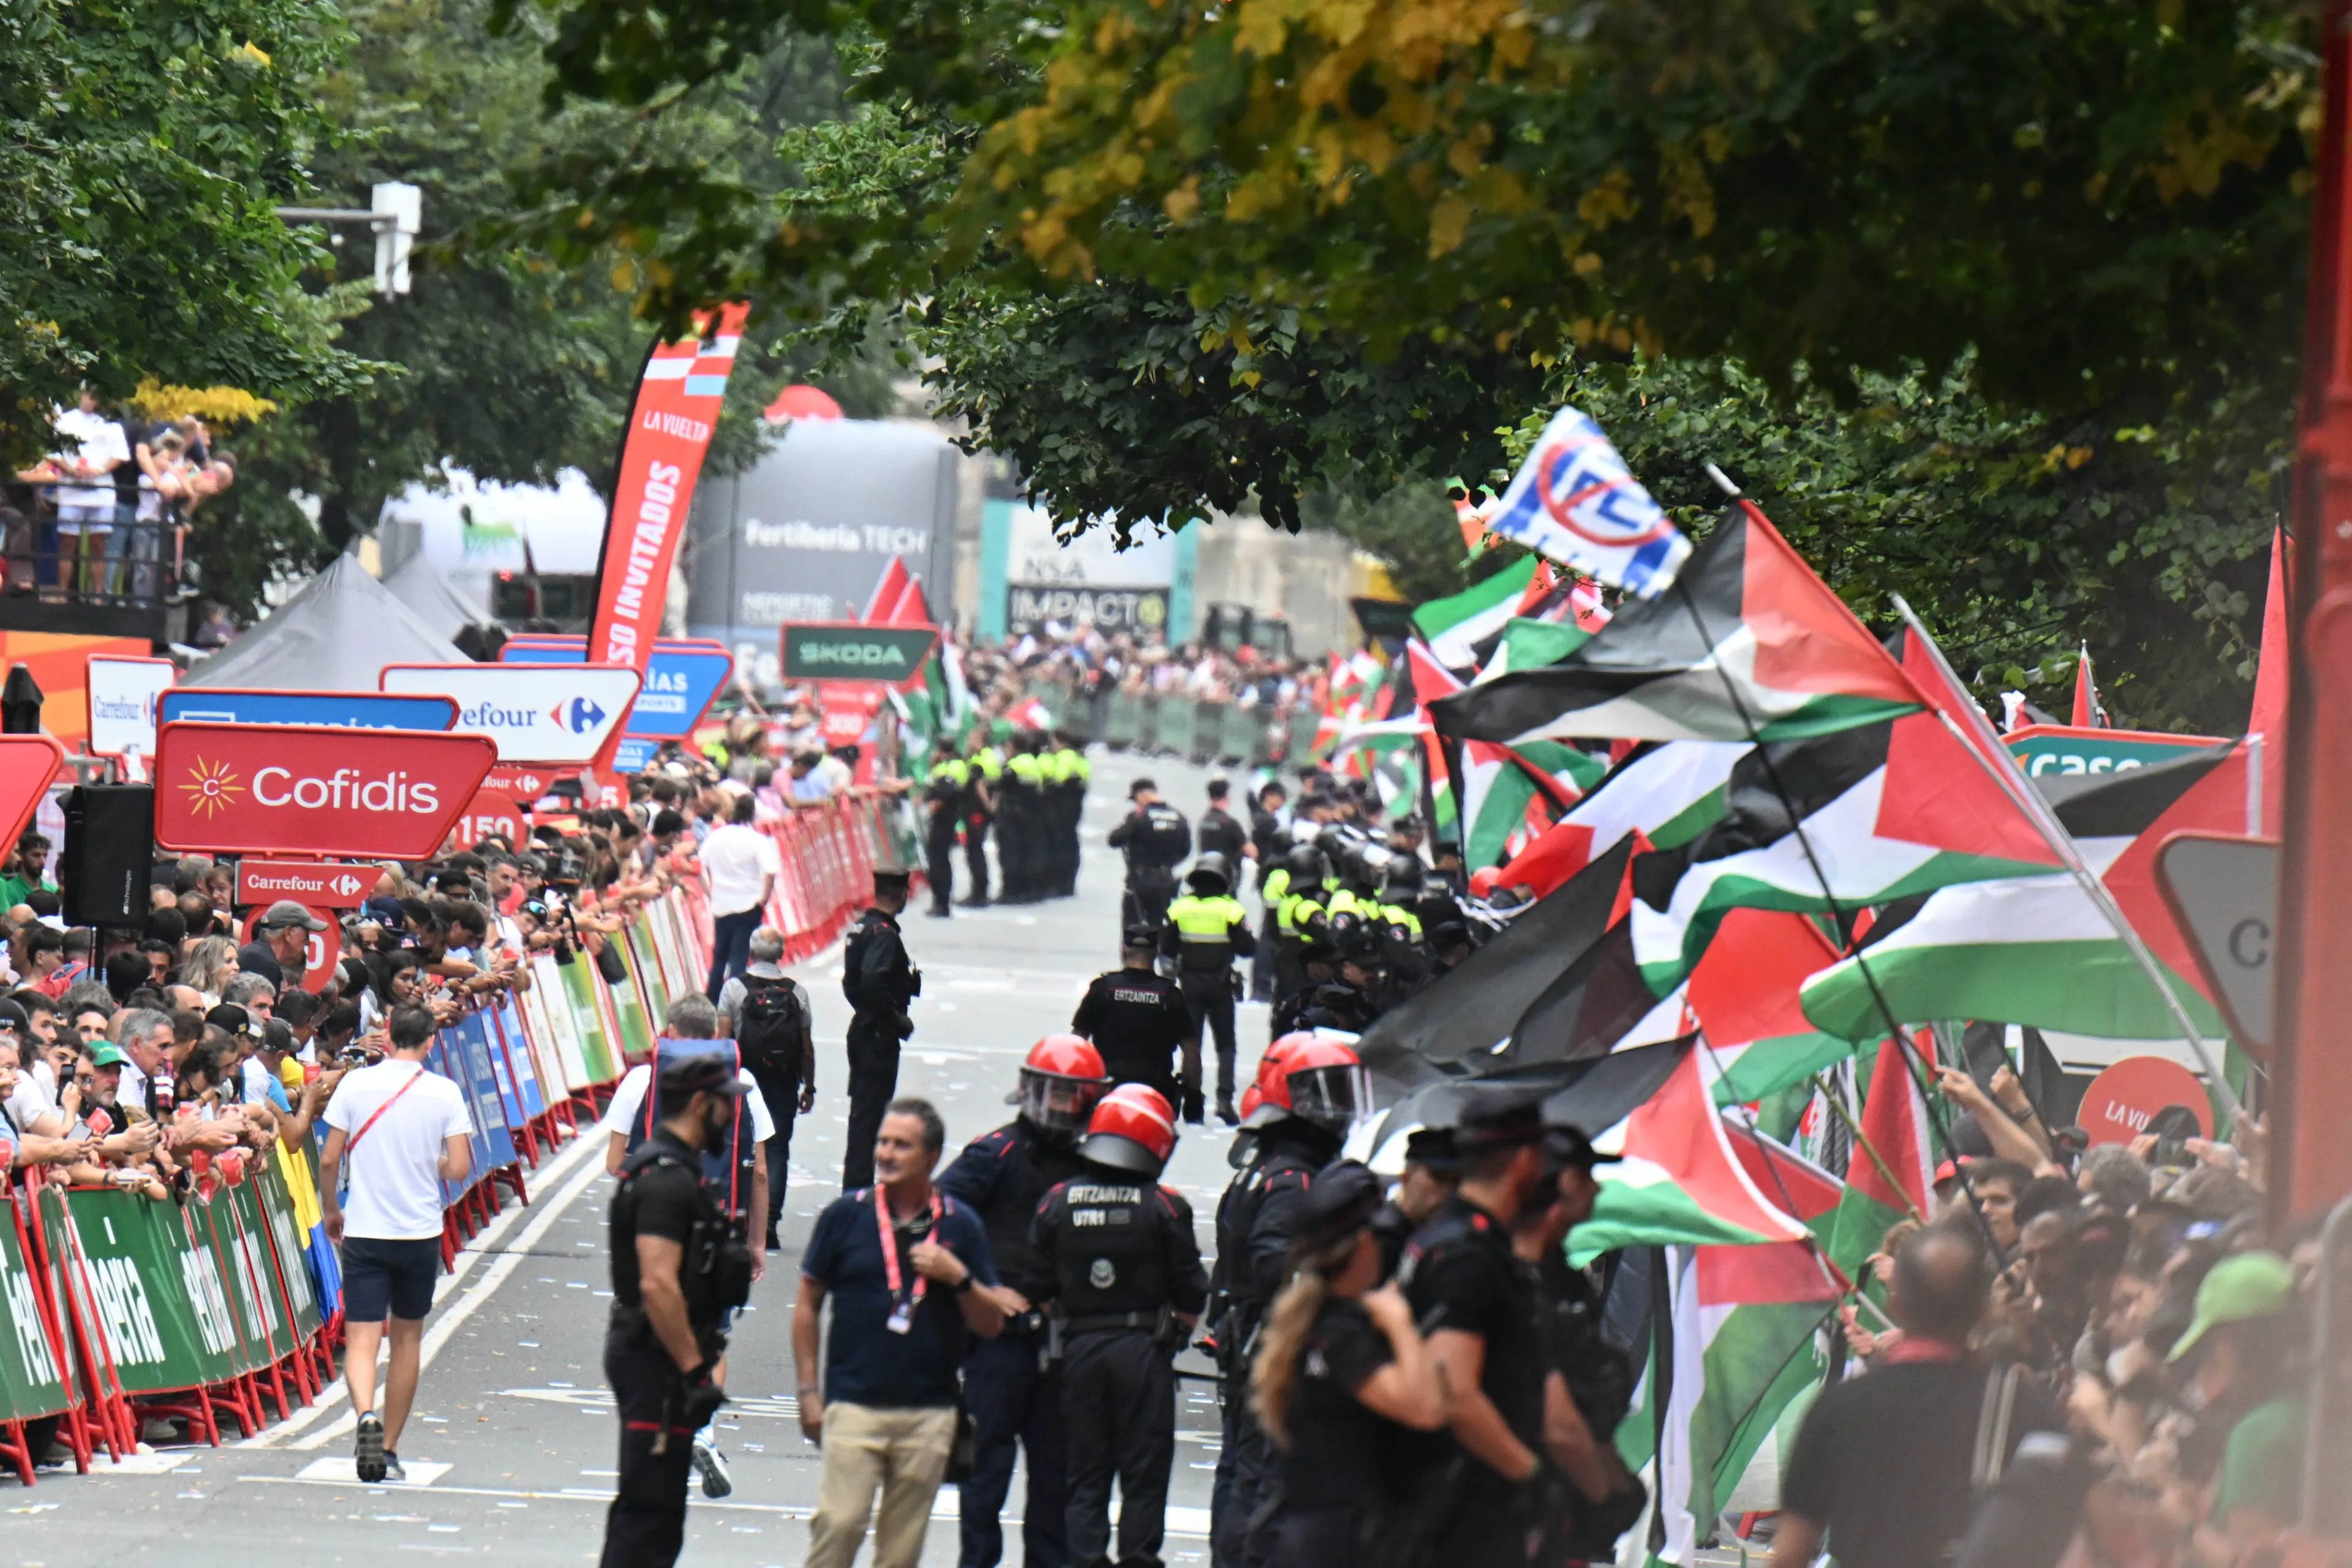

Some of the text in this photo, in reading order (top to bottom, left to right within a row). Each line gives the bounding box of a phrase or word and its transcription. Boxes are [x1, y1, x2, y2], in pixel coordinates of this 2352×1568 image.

[643, 410, 709, 443] LA VUELTA
[614, 460, 681, 621] INVITADOS
[252, 766, 439, 814] Cofidis
[247, 874, 324, 891] Carrefour
[1114, 989, 1160, 1005] ERTZAINTZA
[2105, 1100, 2126, 1125] LA
[1067, 1185, 1142, 1205] ERTZAINTZA
